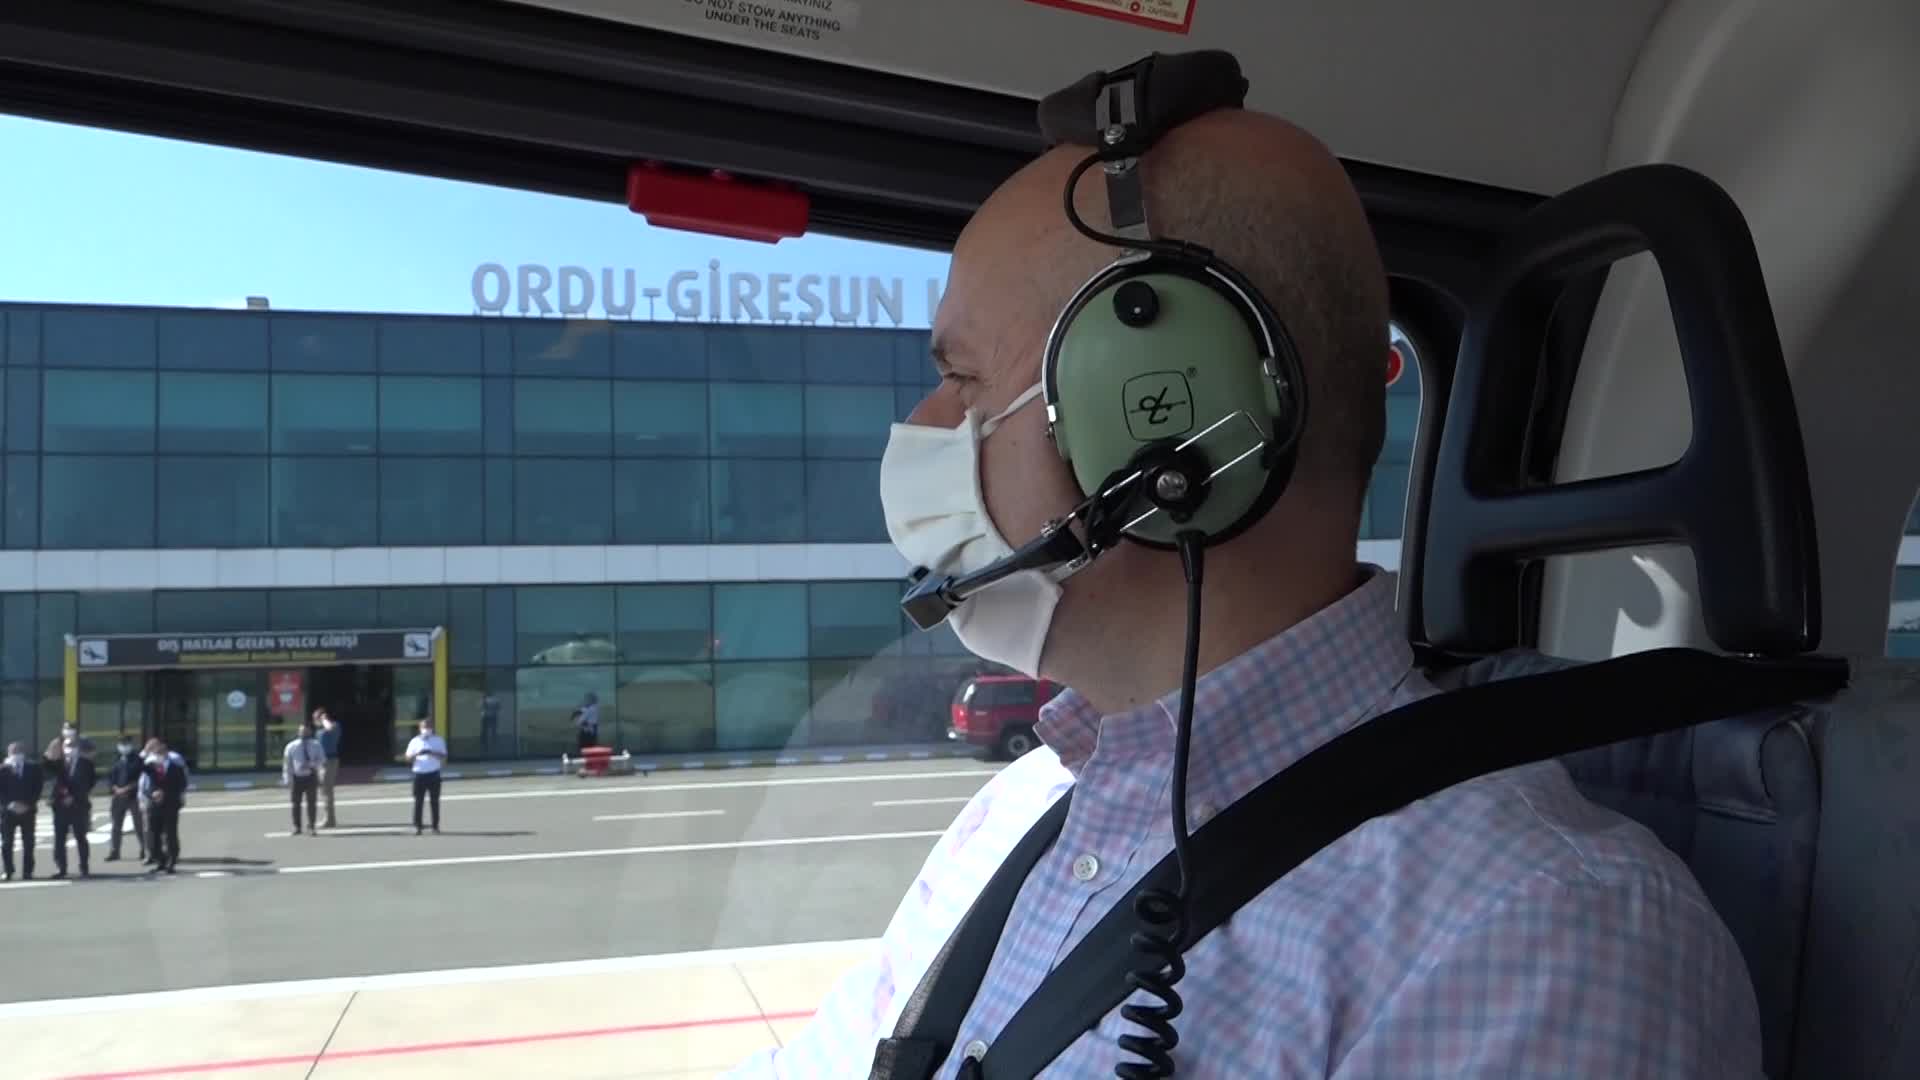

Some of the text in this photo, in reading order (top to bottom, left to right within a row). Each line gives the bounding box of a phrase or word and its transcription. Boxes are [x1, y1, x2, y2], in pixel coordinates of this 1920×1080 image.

[705, 10, 821, 40] UNDER THE SEATS
[707, 0, 841, 32] NOT STOW ANYTHING
[277, 634, 318, 648] YOLCU
